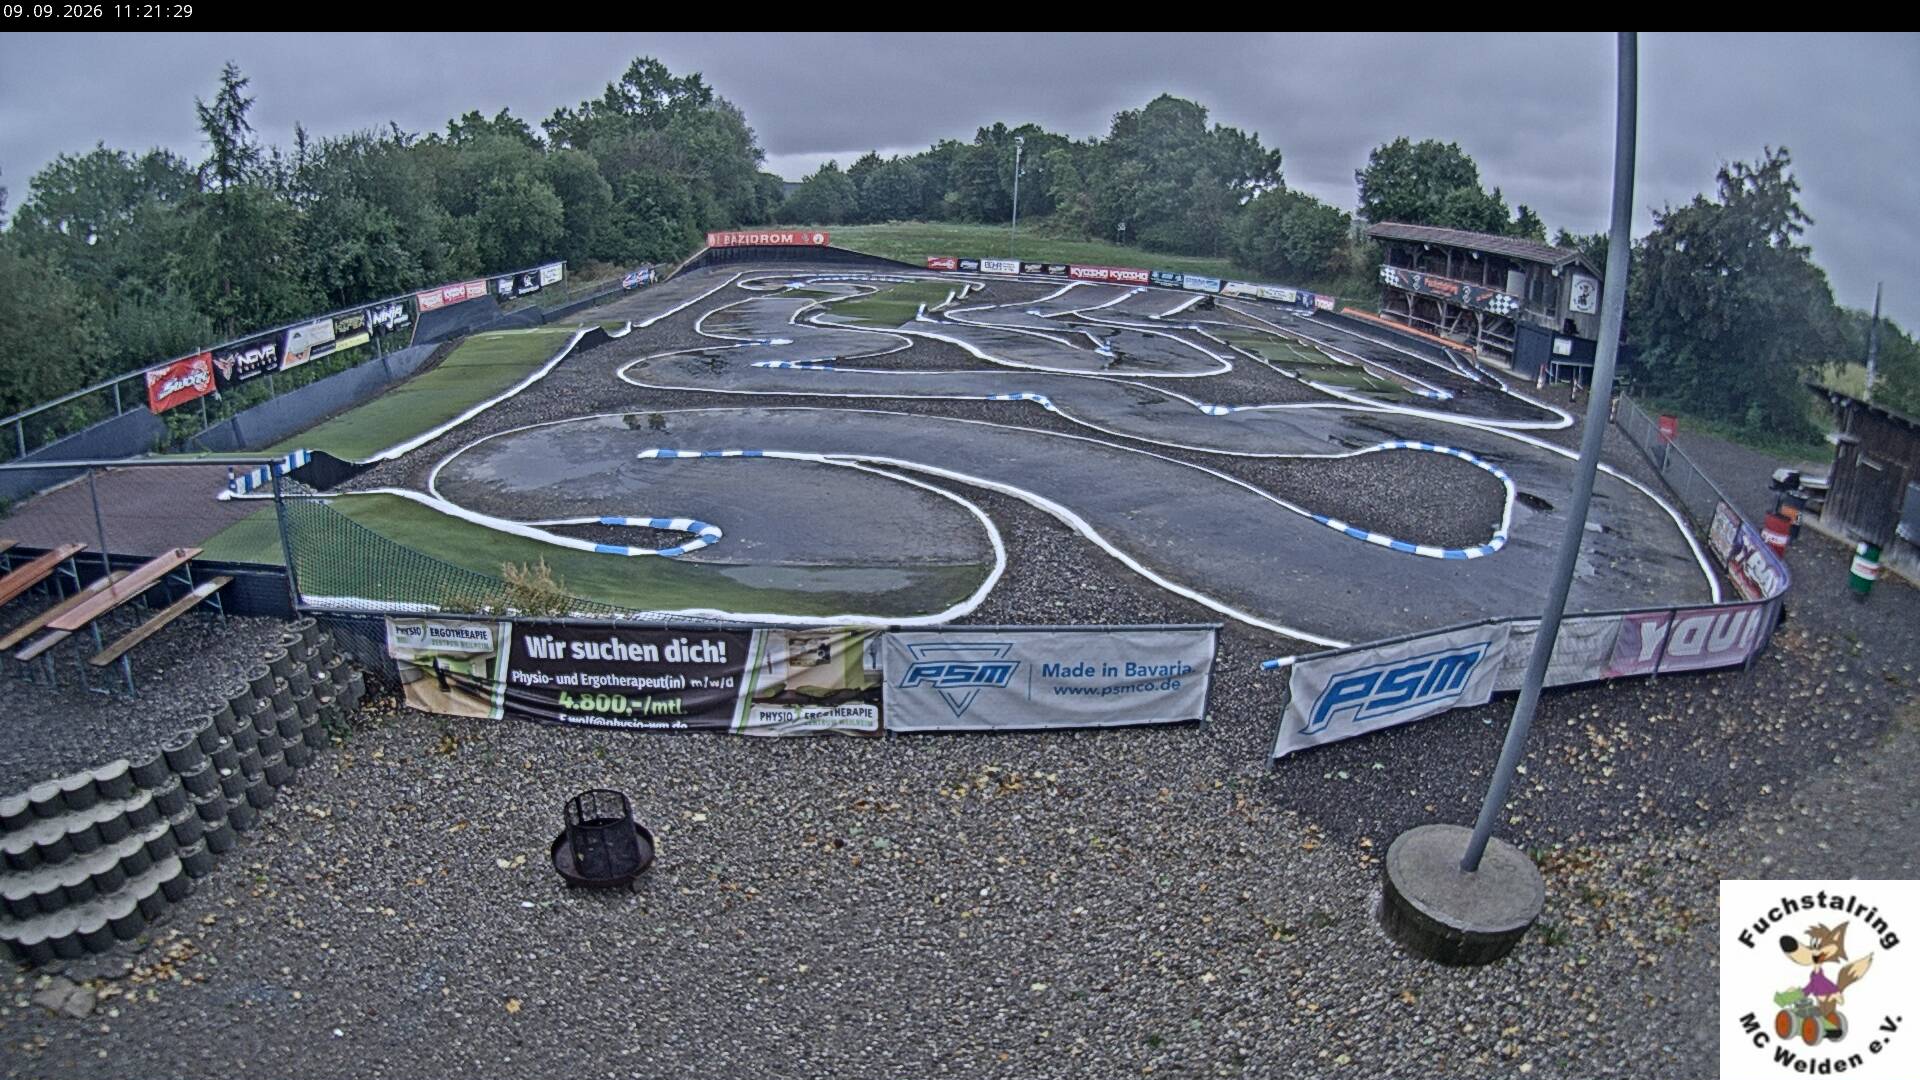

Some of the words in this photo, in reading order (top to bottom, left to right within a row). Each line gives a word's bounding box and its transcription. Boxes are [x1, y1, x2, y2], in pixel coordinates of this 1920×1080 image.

[723, 233, 794, 245] BAZIDROM
[1070, 266, 1108, 278] KYOSHO
[1109, 269, 1149, 281] KYOSHO
[430, 627, 489, 641] ERGOTHERAPIE
[524, 635, 567, 661] Wir
[571, 637, 659, 662] suchen
[664, 638, 728, 664] dich!
[905, 664, 1016, 685] PSM
[1041, 663, 1096, 678] Made
[1102, 662, 1118, 678] in
[512, 671, 554, 686] Physio-
[556, 672, 578, 686] und
[580, 673, 686, 690] Ergotherapeut(in)
[690, 676, 735, 690] m/w/d
[1053, 678, 1181, 697] www.psmco.de
[1307, 646, 1486, 729] PSM
[759, 711, 794, 723] PHYSIO
[804, 707, 873, 720] ERGHERAPIE
